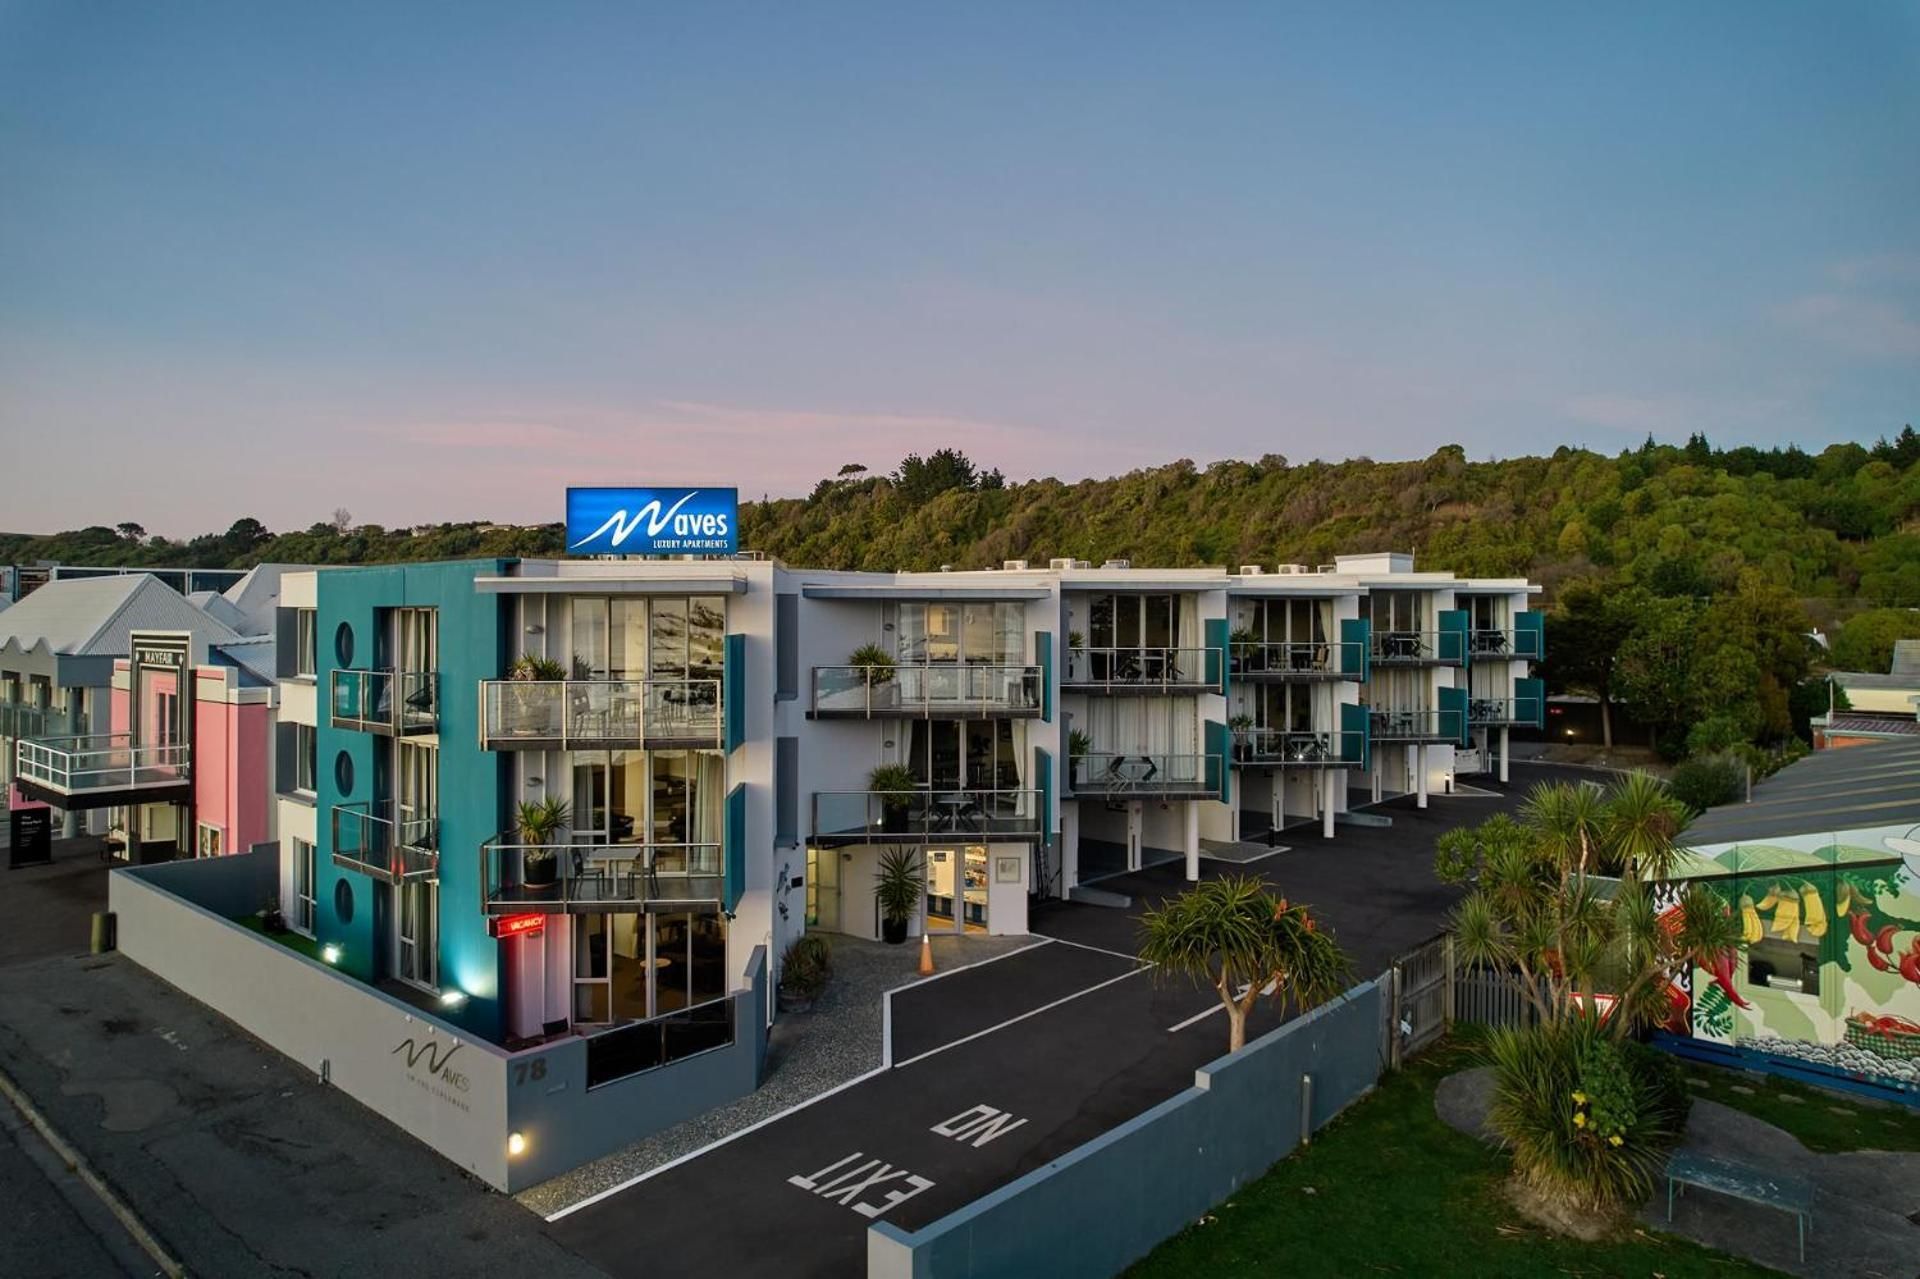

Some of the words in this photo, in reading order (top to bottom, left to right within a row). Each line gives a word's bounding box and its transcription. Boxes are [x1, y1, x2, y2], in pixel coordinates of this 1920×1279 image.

[570, 490, 728, 547] Waves
[653, 540, 681, 549] LUXURY
[682, 540, 728, 549] APARTMENTS
[510, 917, 543, 930] VACANCY
[514, 1058, 547, 1086] 78
[929, 1104, 1029, 1148] NO
[787, 1152, 936, 1218] EXIT
